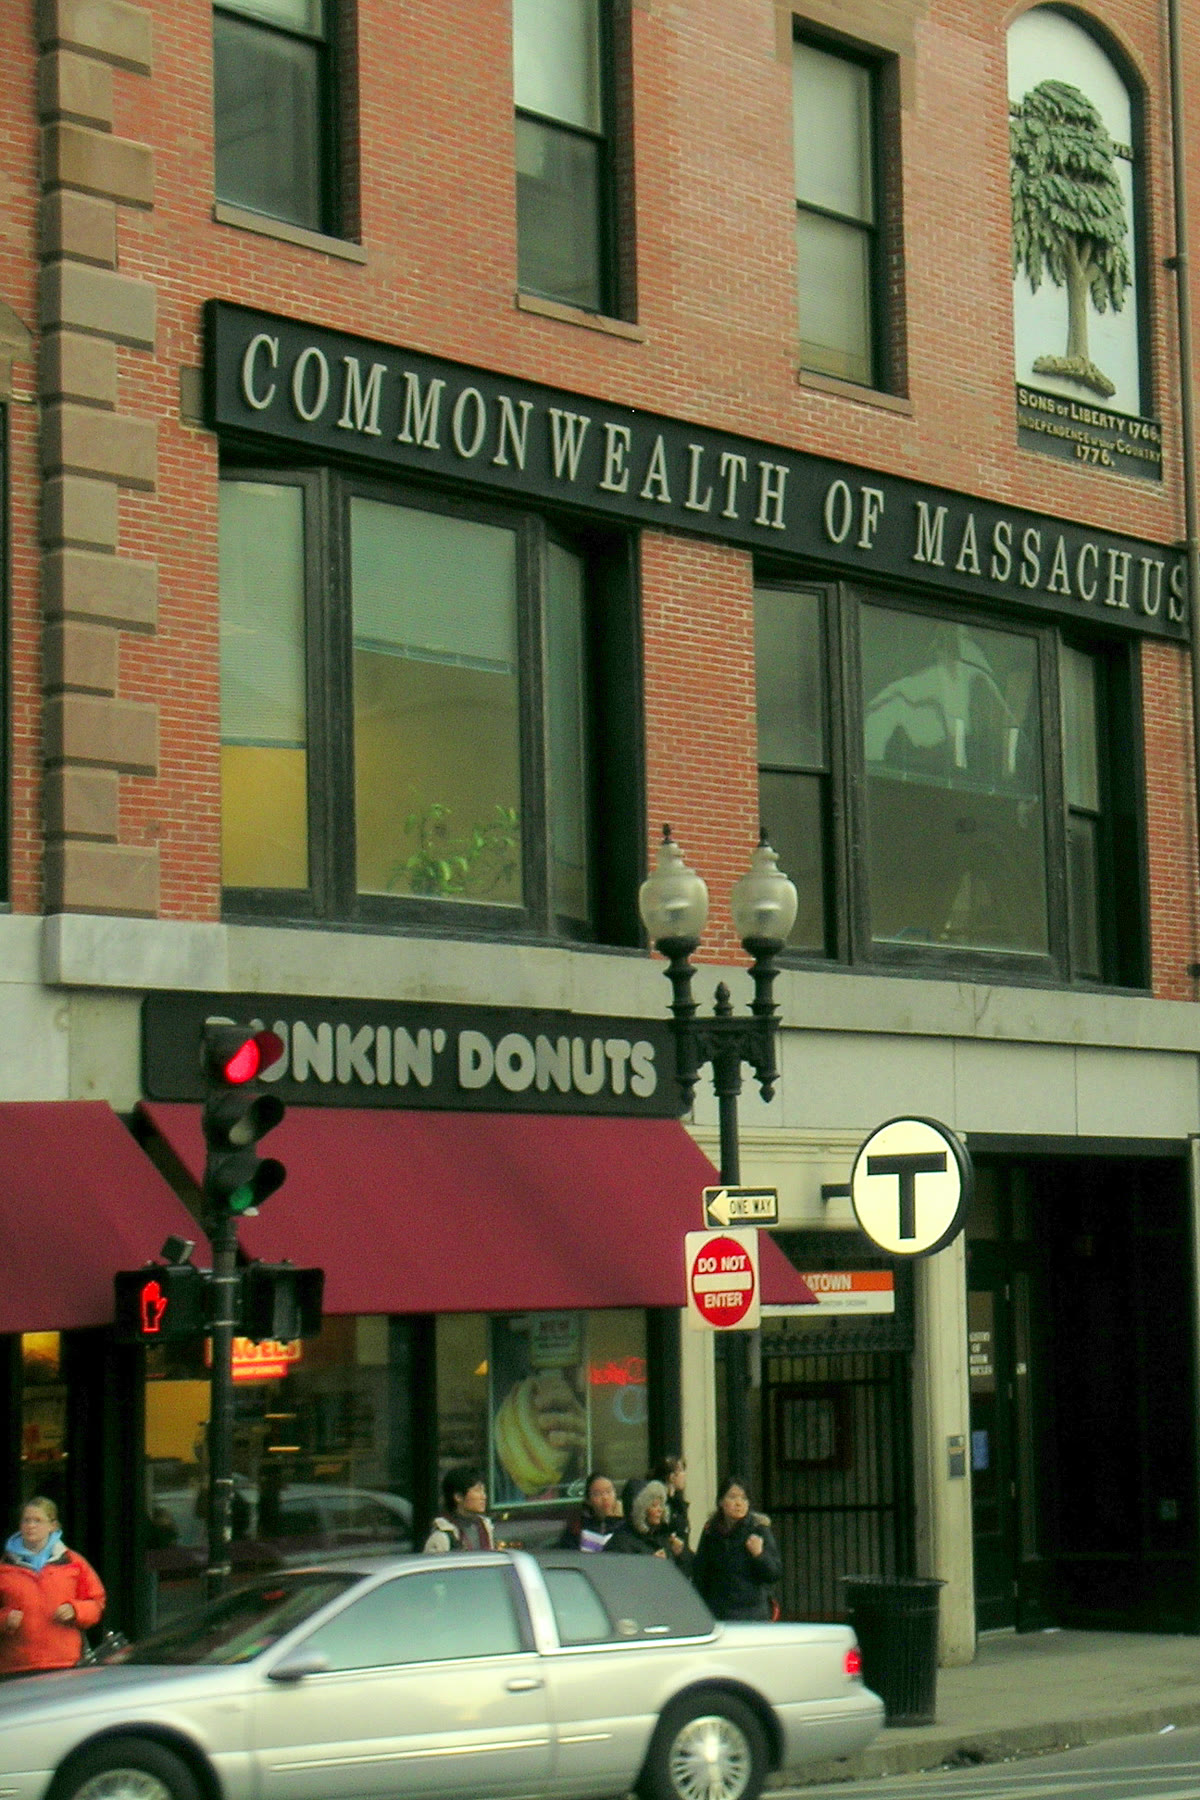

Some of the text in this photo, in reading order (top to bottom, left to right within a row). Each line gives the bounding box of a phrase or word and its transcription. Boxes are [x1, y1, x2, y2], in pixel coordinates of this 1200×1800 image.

[1019, 389, 1055, 413] SONS
[1071, 403, 1125, 431] LIBERTY
[242, 332, 789, 530] COMMONWEALTH
[824, 479, 885, 550] OF
[205, 1016, 657, 1099] UNKIN' DONUTS
[729, 1199, 771, 1214] ONE WAY
[867, 1151, 947, 1240] T
[698, 1255, 746, 1273] DO NOT
[704, 1292, 743, 1308] ENTER
